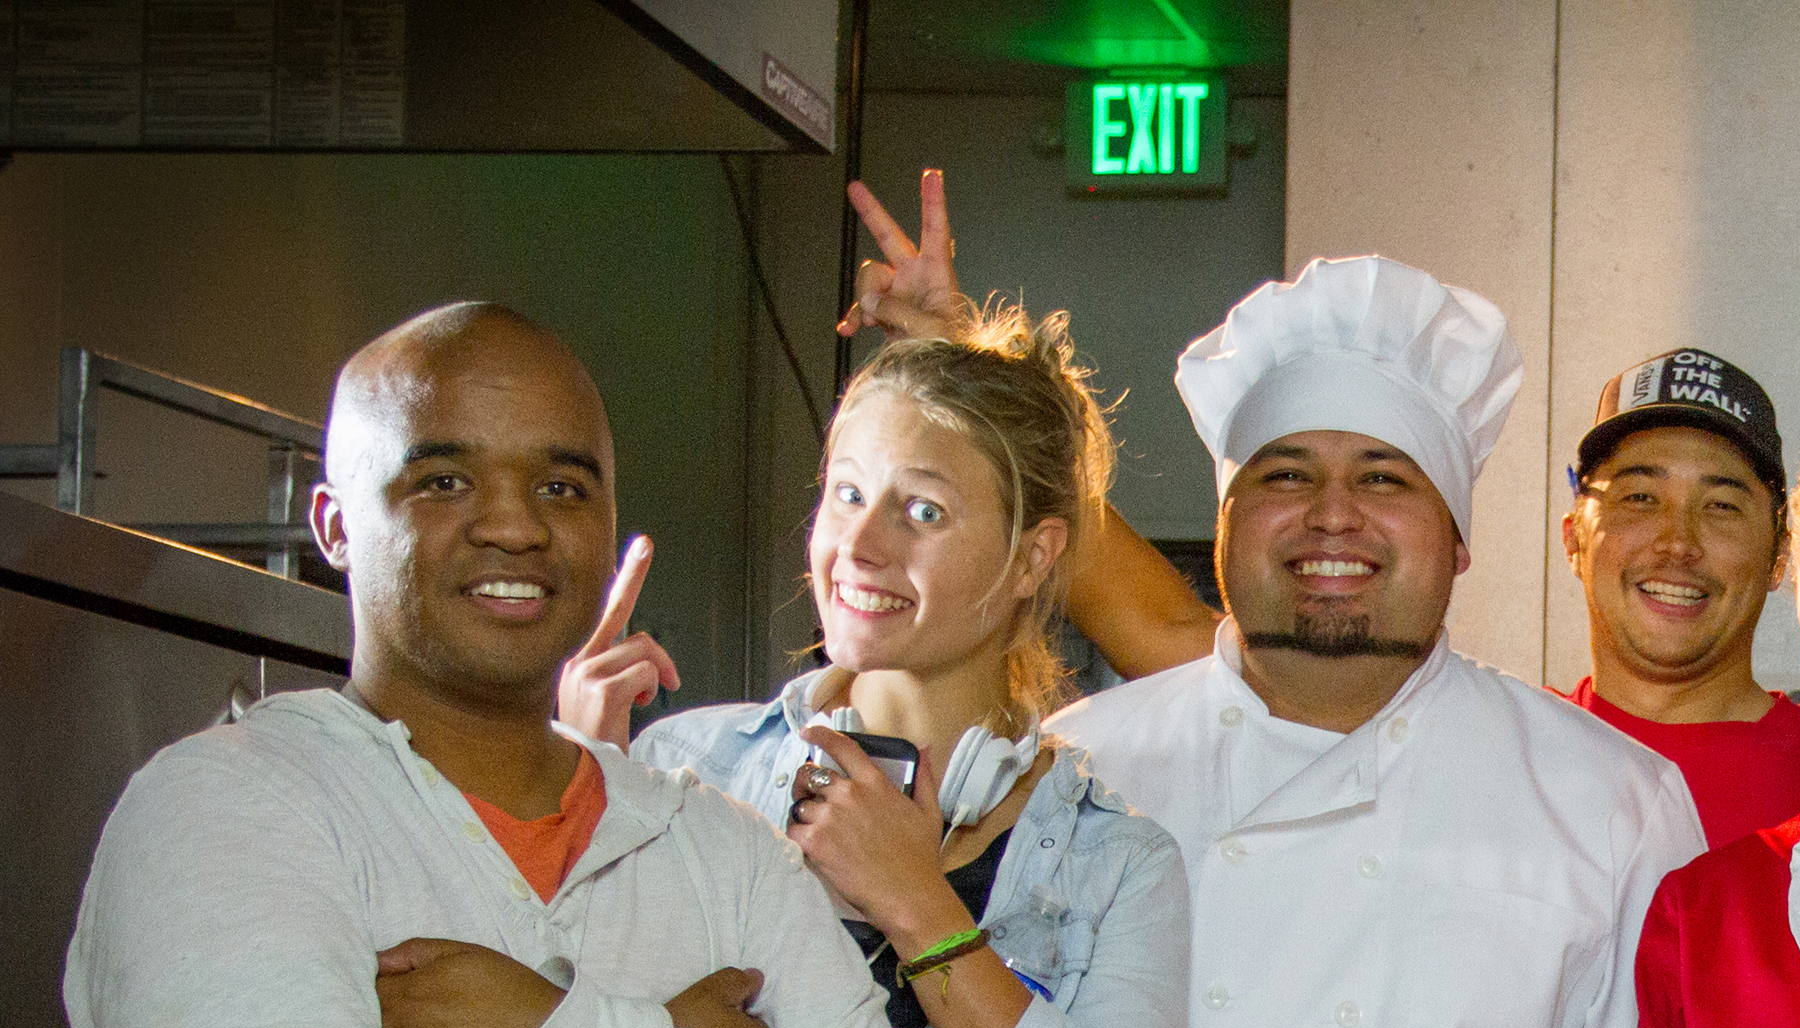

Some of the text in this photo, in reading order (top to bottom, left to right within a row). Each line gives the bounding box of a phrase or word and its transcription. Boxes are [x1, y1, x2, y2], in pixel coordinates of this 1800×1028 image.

[1092, 82, 1209, 175] EXIT
[1672, 367, 1722, 389] THE
[1674, 352, 1723, 371] OFF
[1632, 363, 1655, 405] VANS
[1670, 384, 1746, 423] WALL
